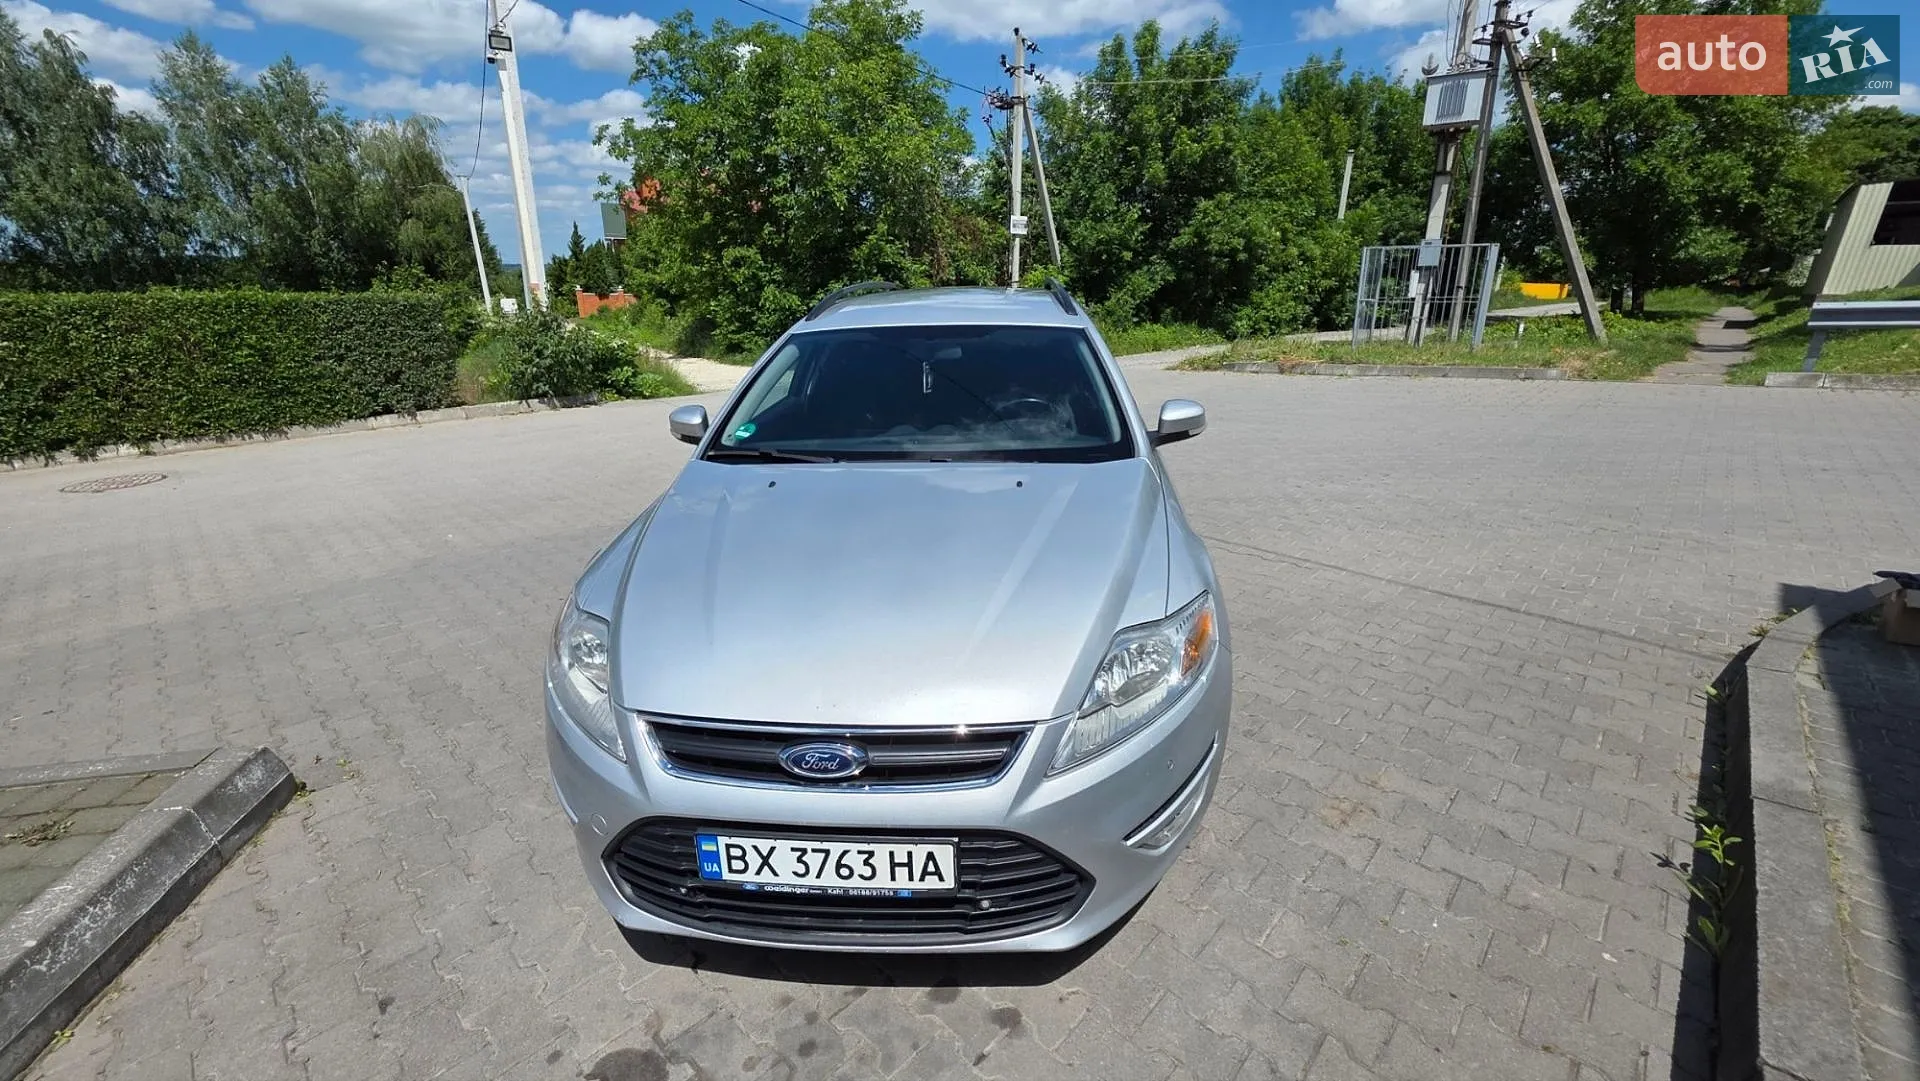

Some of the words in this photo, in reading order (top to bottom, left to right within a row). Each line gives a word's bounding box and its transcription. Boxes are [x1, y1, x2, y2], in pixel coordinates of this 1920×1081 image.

[801, 752, 840, 770] Ford
[704, 862, 720, 873] UA
[724, 843, 780, 877] BX
[790, 847, 877, 881] 3763
[888, 850, 945, 883] HA
